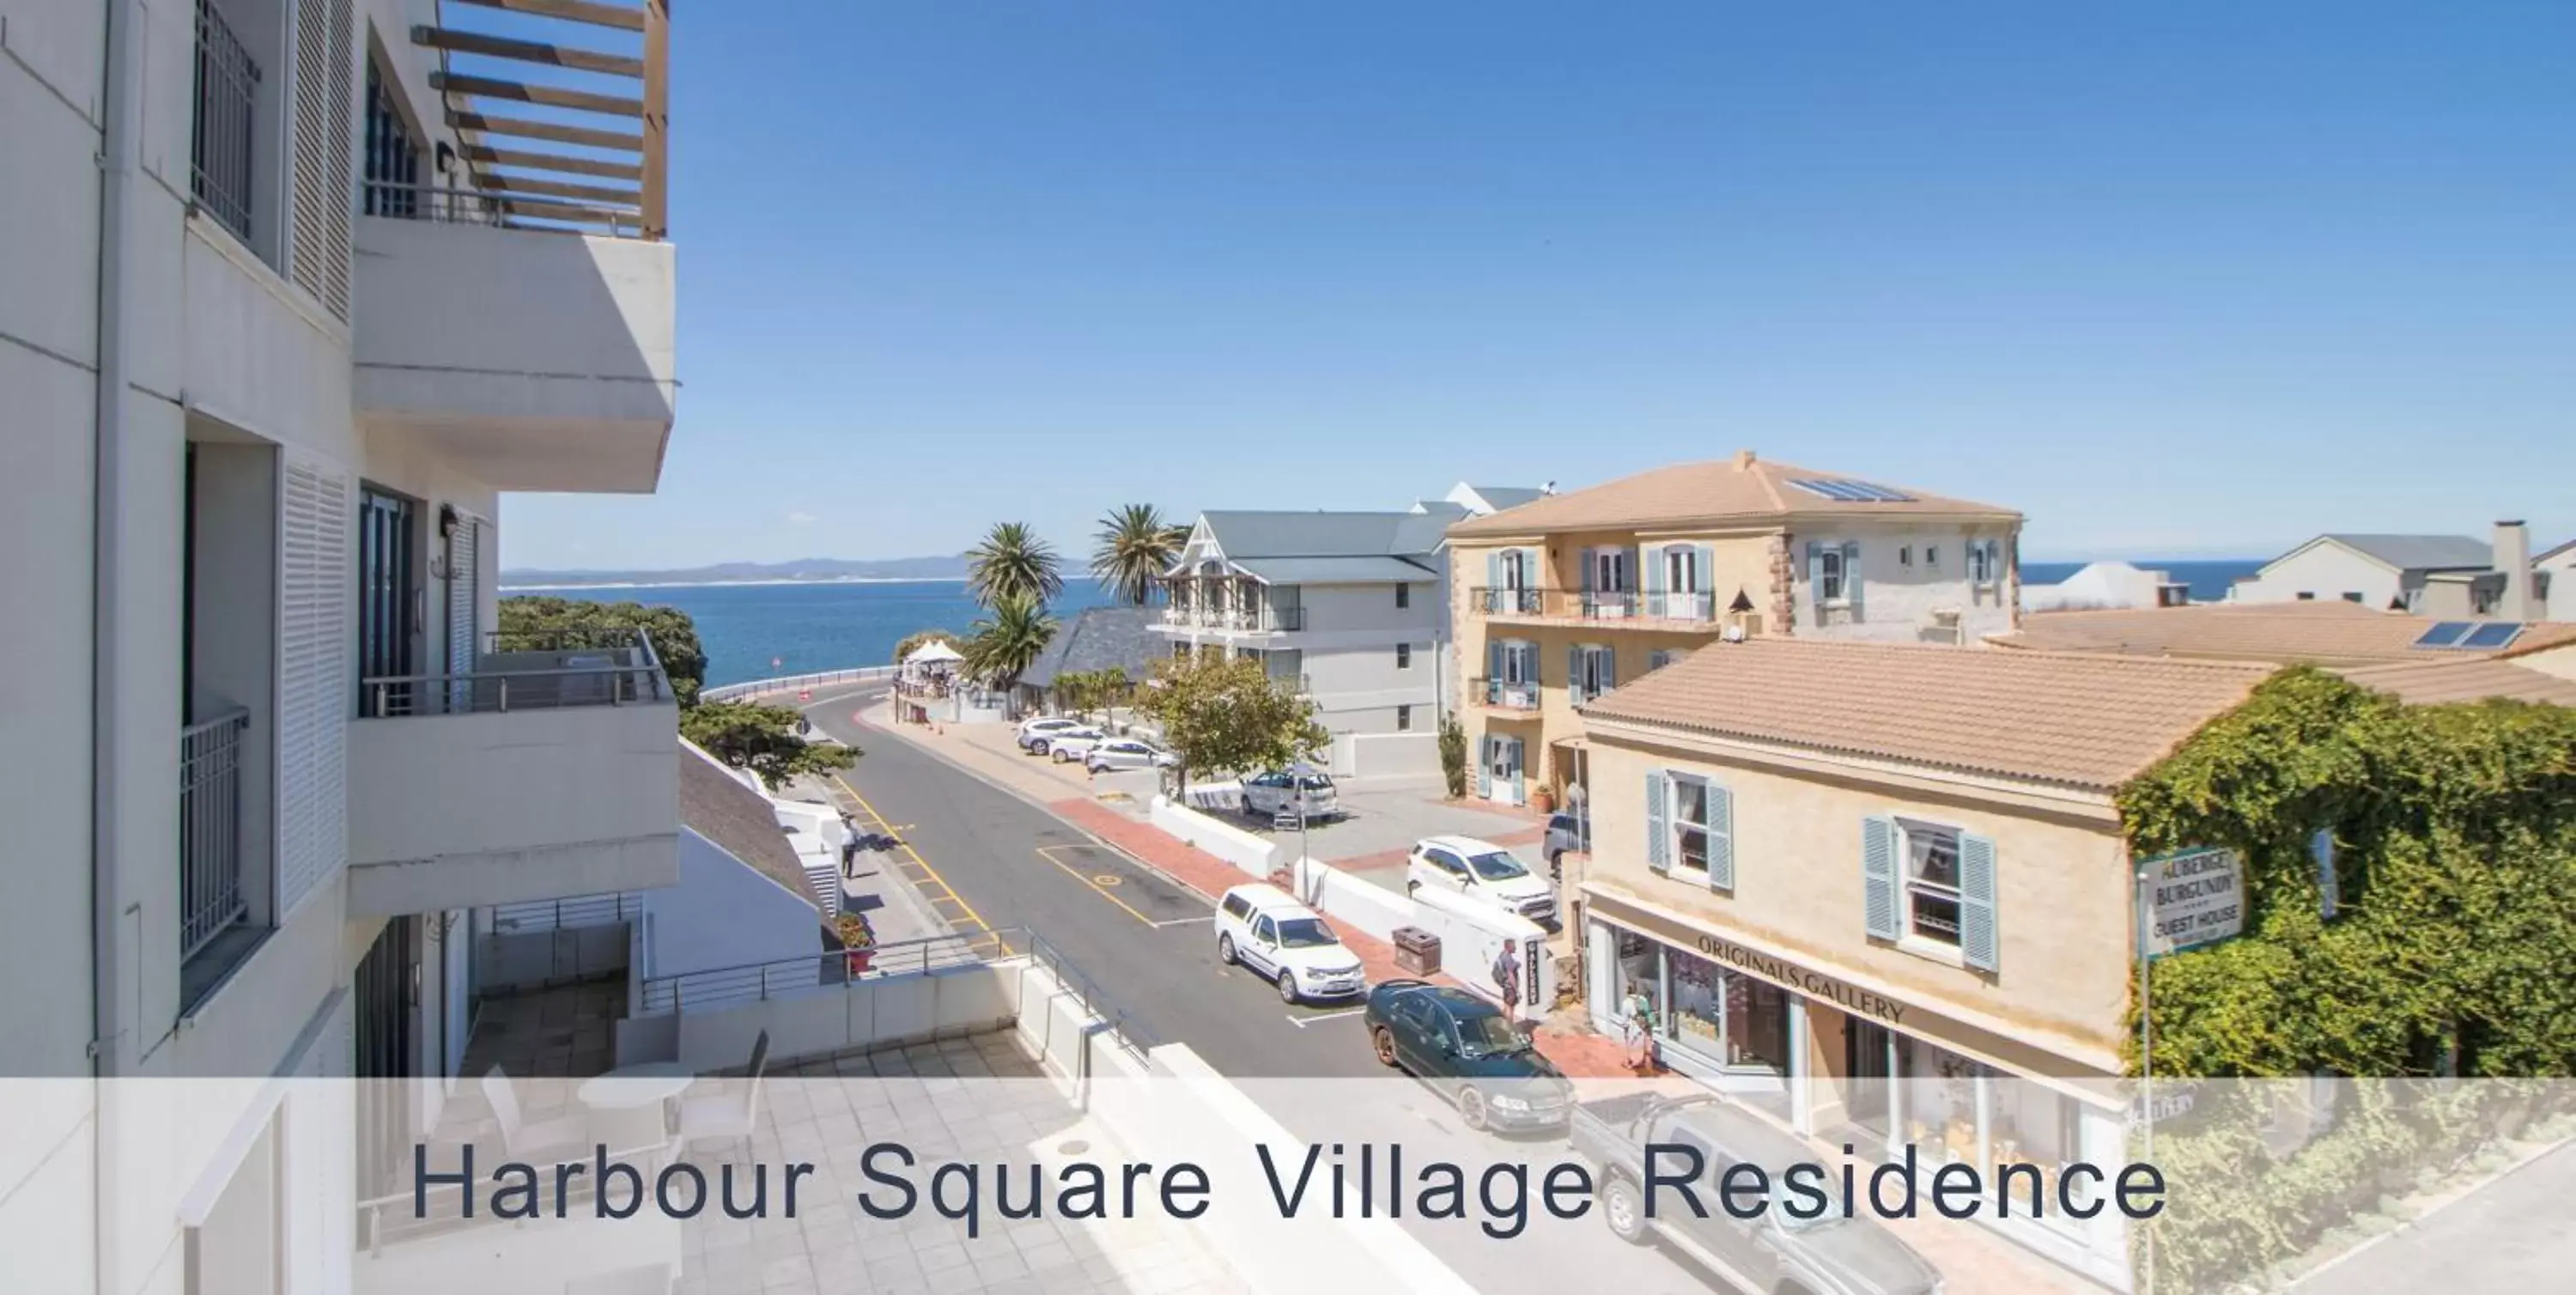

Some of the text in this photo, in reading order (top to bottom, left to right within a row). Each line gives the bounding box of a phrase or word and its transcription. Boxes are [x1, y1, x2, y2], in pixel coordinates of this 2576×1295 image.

[2162, 849, 2230, 879] AUBERGE
[2156, 872, 2235, 906] BURGUNDY
[2154, 915, 2194, 939] GUEST
[2197, 903, 2239, 927] HOUSE
[1528, 943, 1537, 1004] GALLERY
[1698, 935, 1906, 1024] ORIGINALS GALLERY
